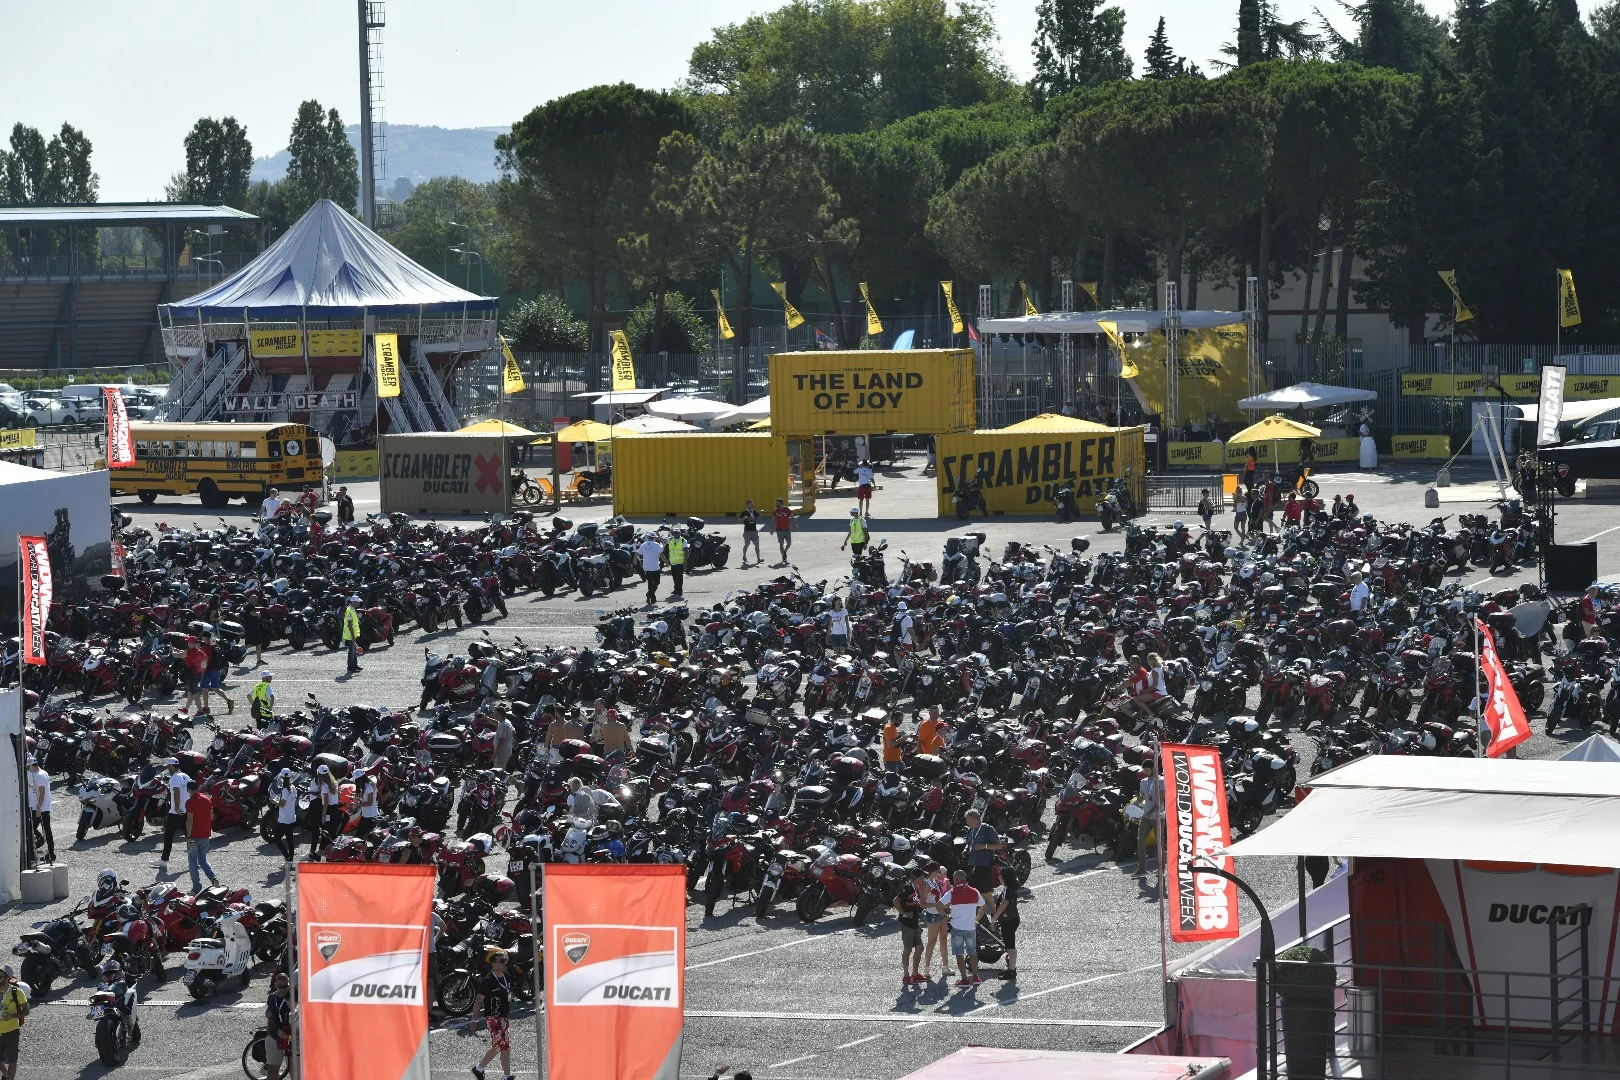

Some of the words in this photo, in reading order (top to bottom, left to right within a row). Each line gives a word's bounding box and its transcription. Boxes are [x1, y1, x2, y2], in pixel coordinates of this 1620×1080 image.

[257, 335, 296, 347] SCRAMBLER
[381, 343, 396, 386] SCRAMBLER
[618, 339, 632, 381] SCRAMBLER
[1190, 359, 1221, 369] LAND
[793, 373, 844, 390] THE
[853, 372, 923, 389] LAND
[1574, 380, 1608, 392] SCRAMBLER
[224, 396, 277, 411] WALL
[295, 393, 355, 409] DEATH
[814, 393, 849, 410] OF
[856, 392, 904, 409] JOY
[1542, 370, 1560, 441] DUCATI
[1171, 447, 1201, 459] SCRAMBLER
[1228, 445, 1267, 458] SCRALER
[1312, 442, 1338, 454] AMBLER
[1395, 440, 1426, 452] SCRAMBLER
[145, 460, 187, 474] SCRAMBLER
[384, 453, 471, 479] SCRAMBLER
[942, 436, 1115, 494] SCRAMBLER
[423, 480, 469, 493] DUCATI
[1189, 755, 1229, 930] WDW2018
[1488, 903, 1593, 925] DUCATI
[350, 984, 416, 999] DUCATI
[603, 985, 671, 1000] DUCATI
